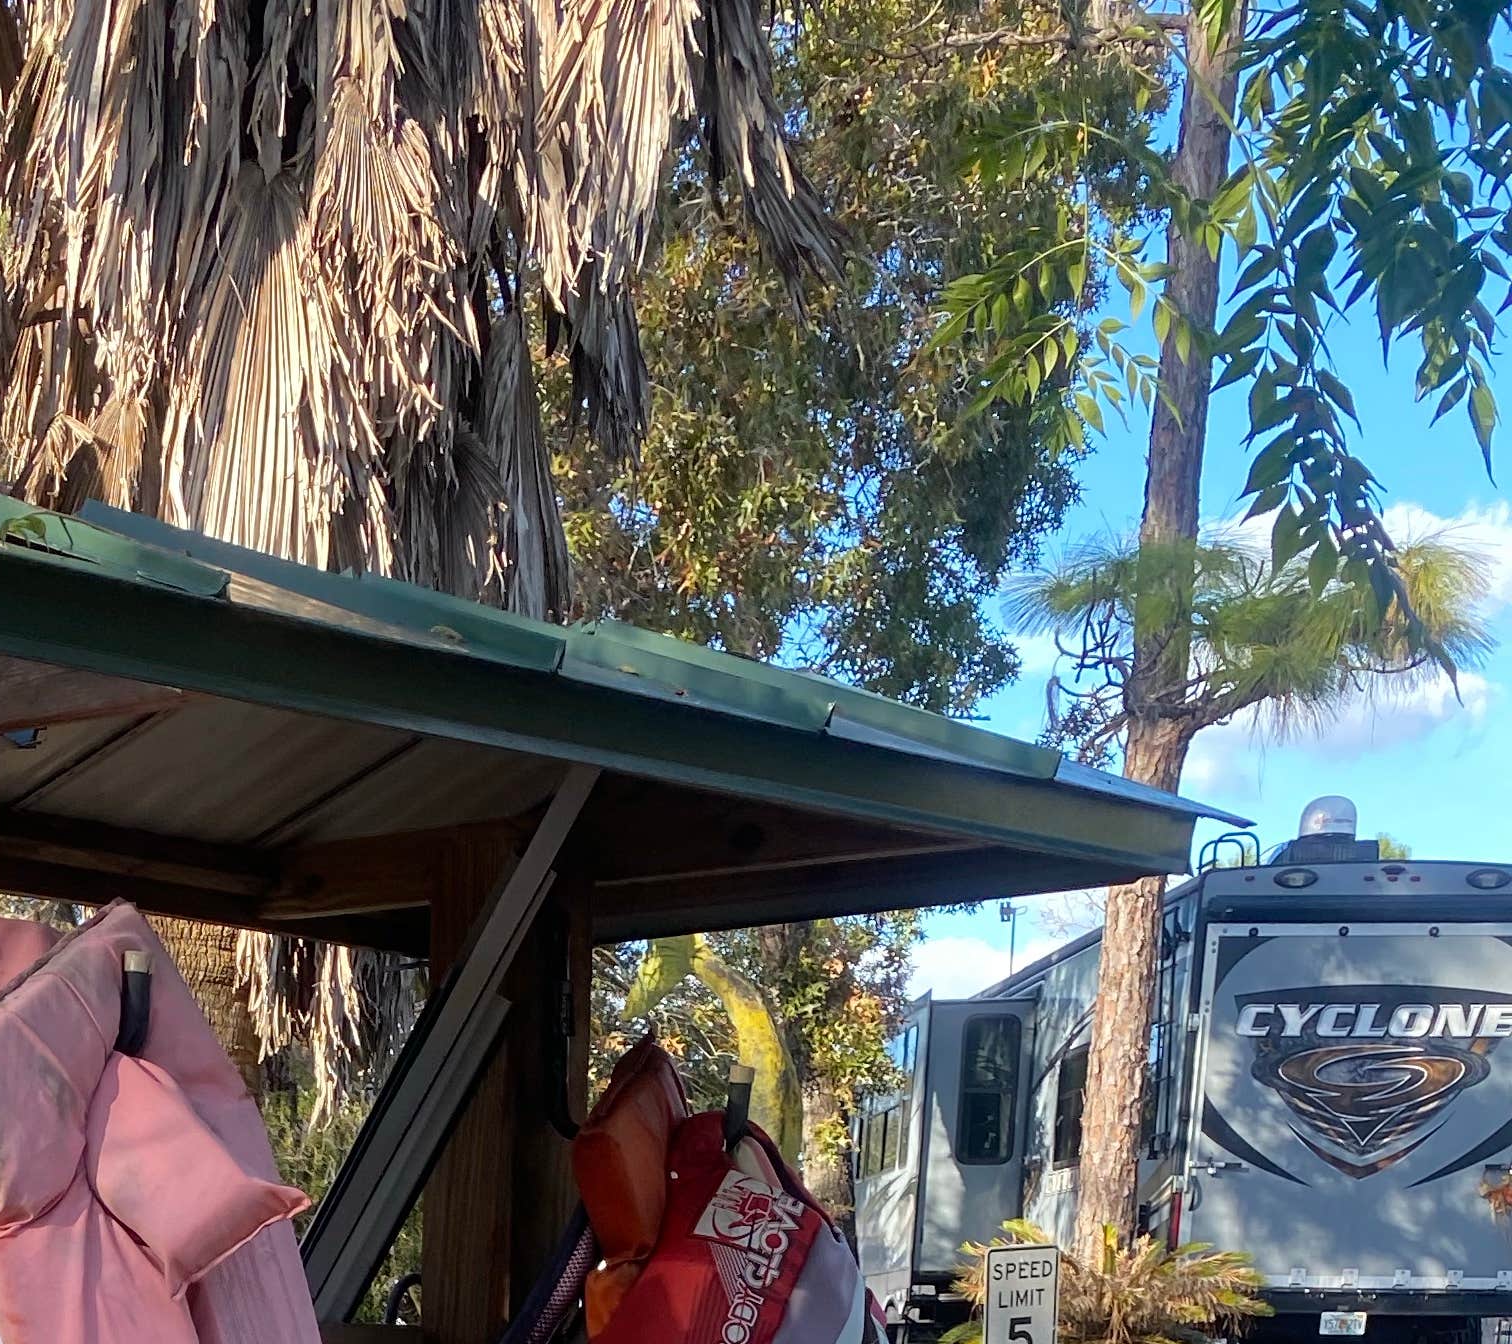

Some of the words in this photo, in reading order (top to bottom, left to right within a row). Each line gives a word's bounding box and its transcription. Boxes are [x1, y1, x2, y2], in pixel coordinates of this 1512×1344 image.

[1236, 1003, 1512, 1038] CYCLONE
[742, 1191, 804, 1289] GLOVE
[992, 1260, 1053, 1281] SPEED
[998, 1288, 1045, 1308] LIMIT
